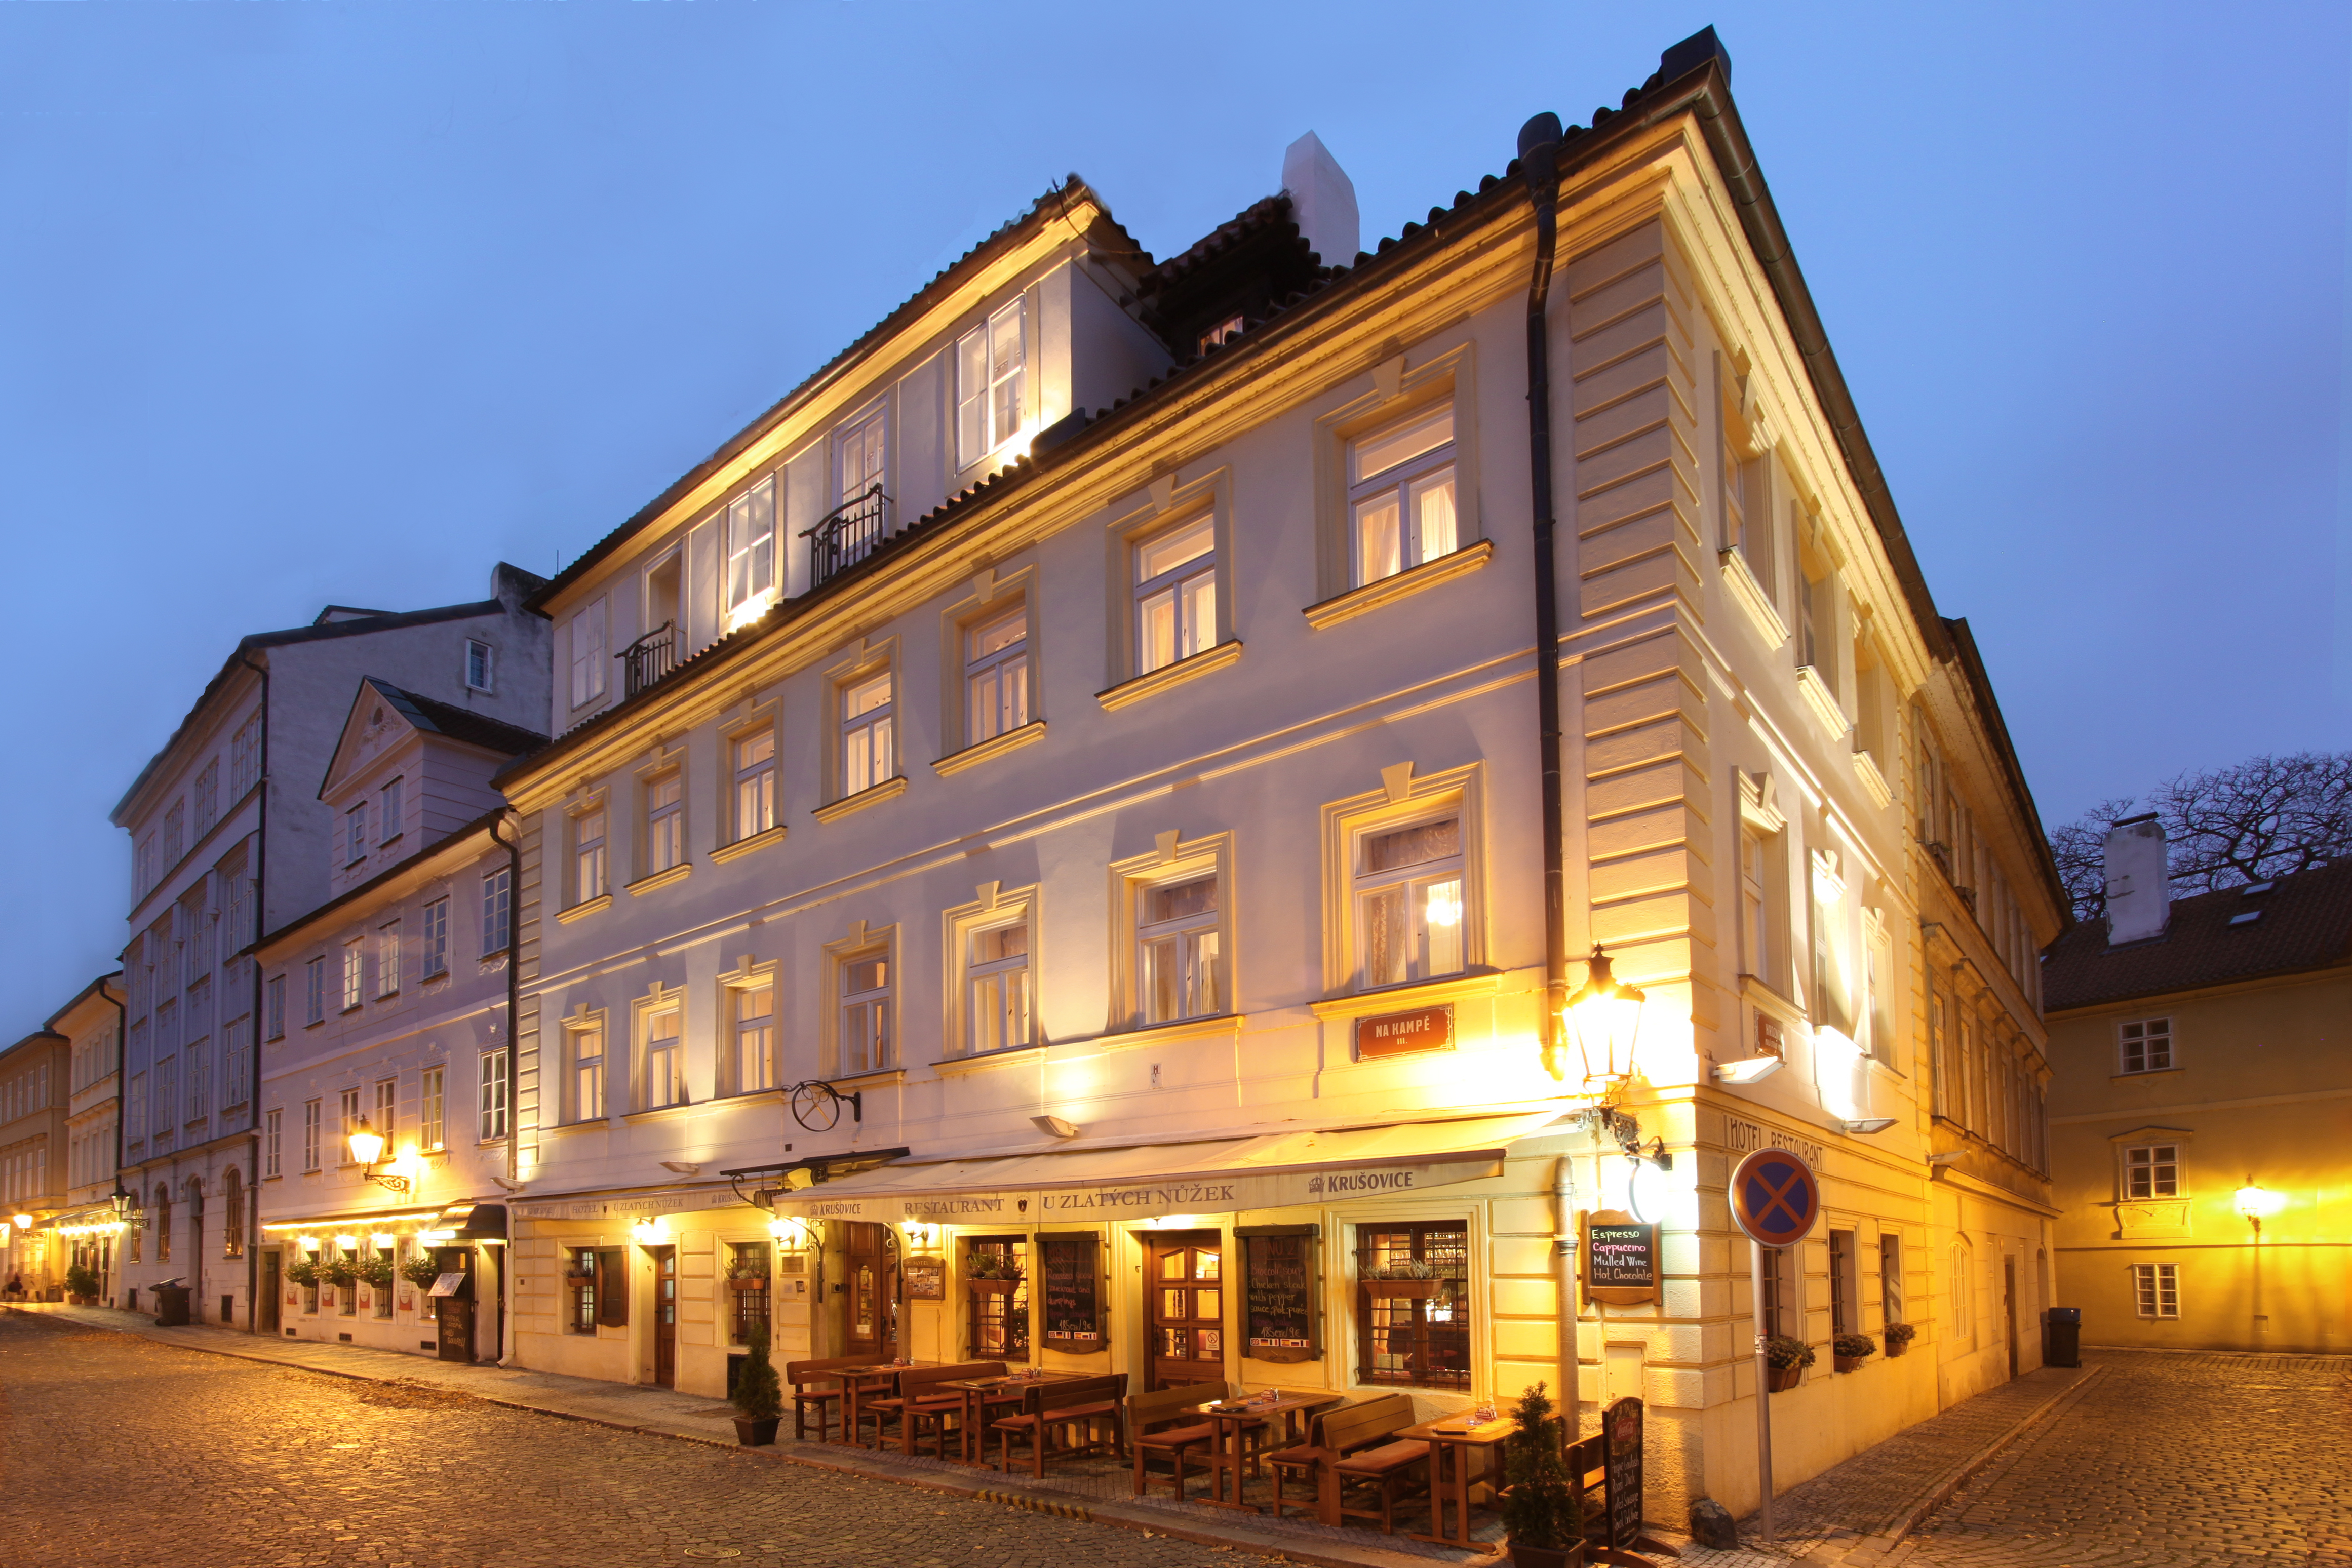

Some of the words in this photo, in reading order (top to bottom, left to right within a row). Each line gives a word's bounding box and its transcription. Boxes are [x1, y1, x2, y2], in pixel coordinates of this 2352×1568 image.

[1376, 1024, 1389, 1038] NA
[1392, 1015, 1430, 1035] KAMPĚ
[1328, 1171, 1413, 1192] KRUŠOVICE
[1043, 1196, 1055, 1209] U
[1060, 1188, 1151, 1209] ZLATÝCH
[1156, 1183, 1235, 1204] NŮŽEK
[572, 1205, 598, 1214] HOTEL
[620, 1199, 654, 1211] ZLATÝCH
[820, 1202, 861, 1216] KRUŠOVICE
[904, 1198, 1005, 1214] RESTAURANT
[1592, 1229, 1640, 1242] Espresso
[1593, 1242, 1646, 1256] Cappuccino
[1594, 1254, 1625, 1266] Mulled
[1626, 1255, 1648, 1266] Wine
[1594, 1267, 1612, 1280] Hot
[1614, 1268, 1652, 1280] Chocolate
[1248, 1290, 1266, 1302] with
